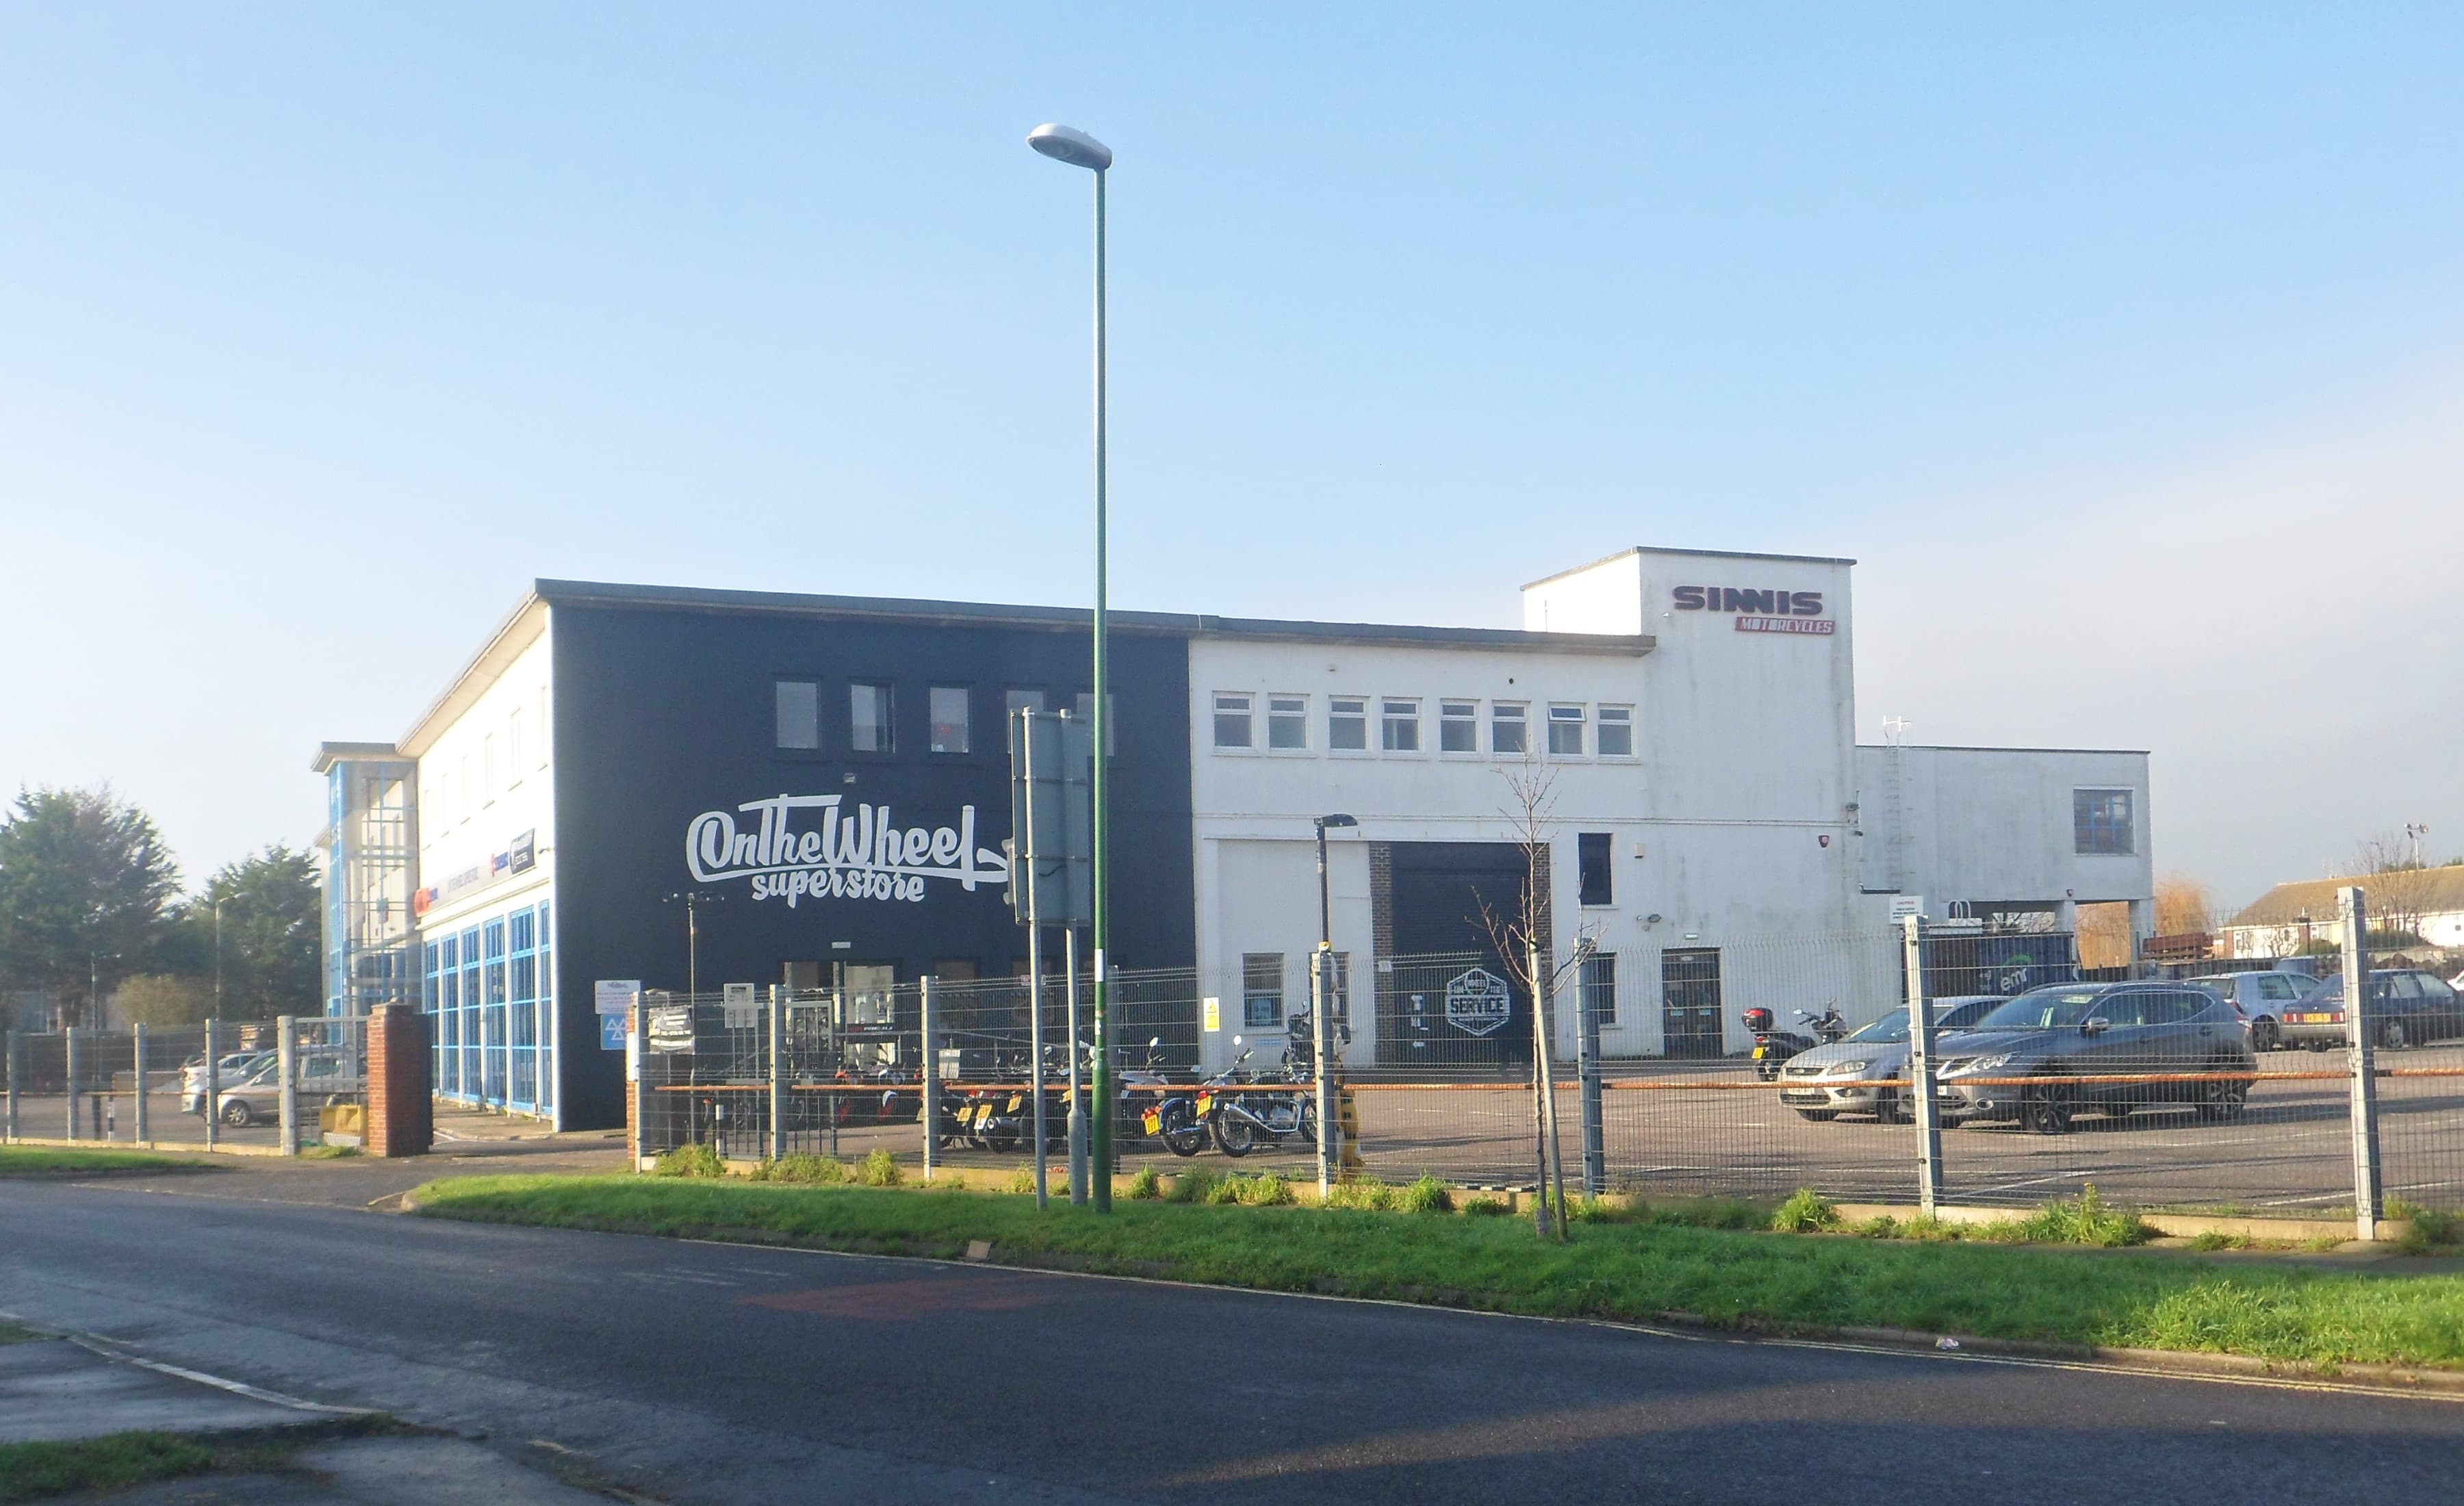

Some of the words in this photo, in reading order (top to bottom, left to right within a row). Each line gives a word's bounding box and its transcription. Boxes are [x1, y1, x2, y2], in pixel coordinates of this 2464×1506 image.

[1673, 585, 1823, 615] SINNIS
[1741, 618, 1832, 633] MOTORCYCLES
[752, 862, 925, 908] superstore
[1450, 997, 1504, 1013] SERVICE
